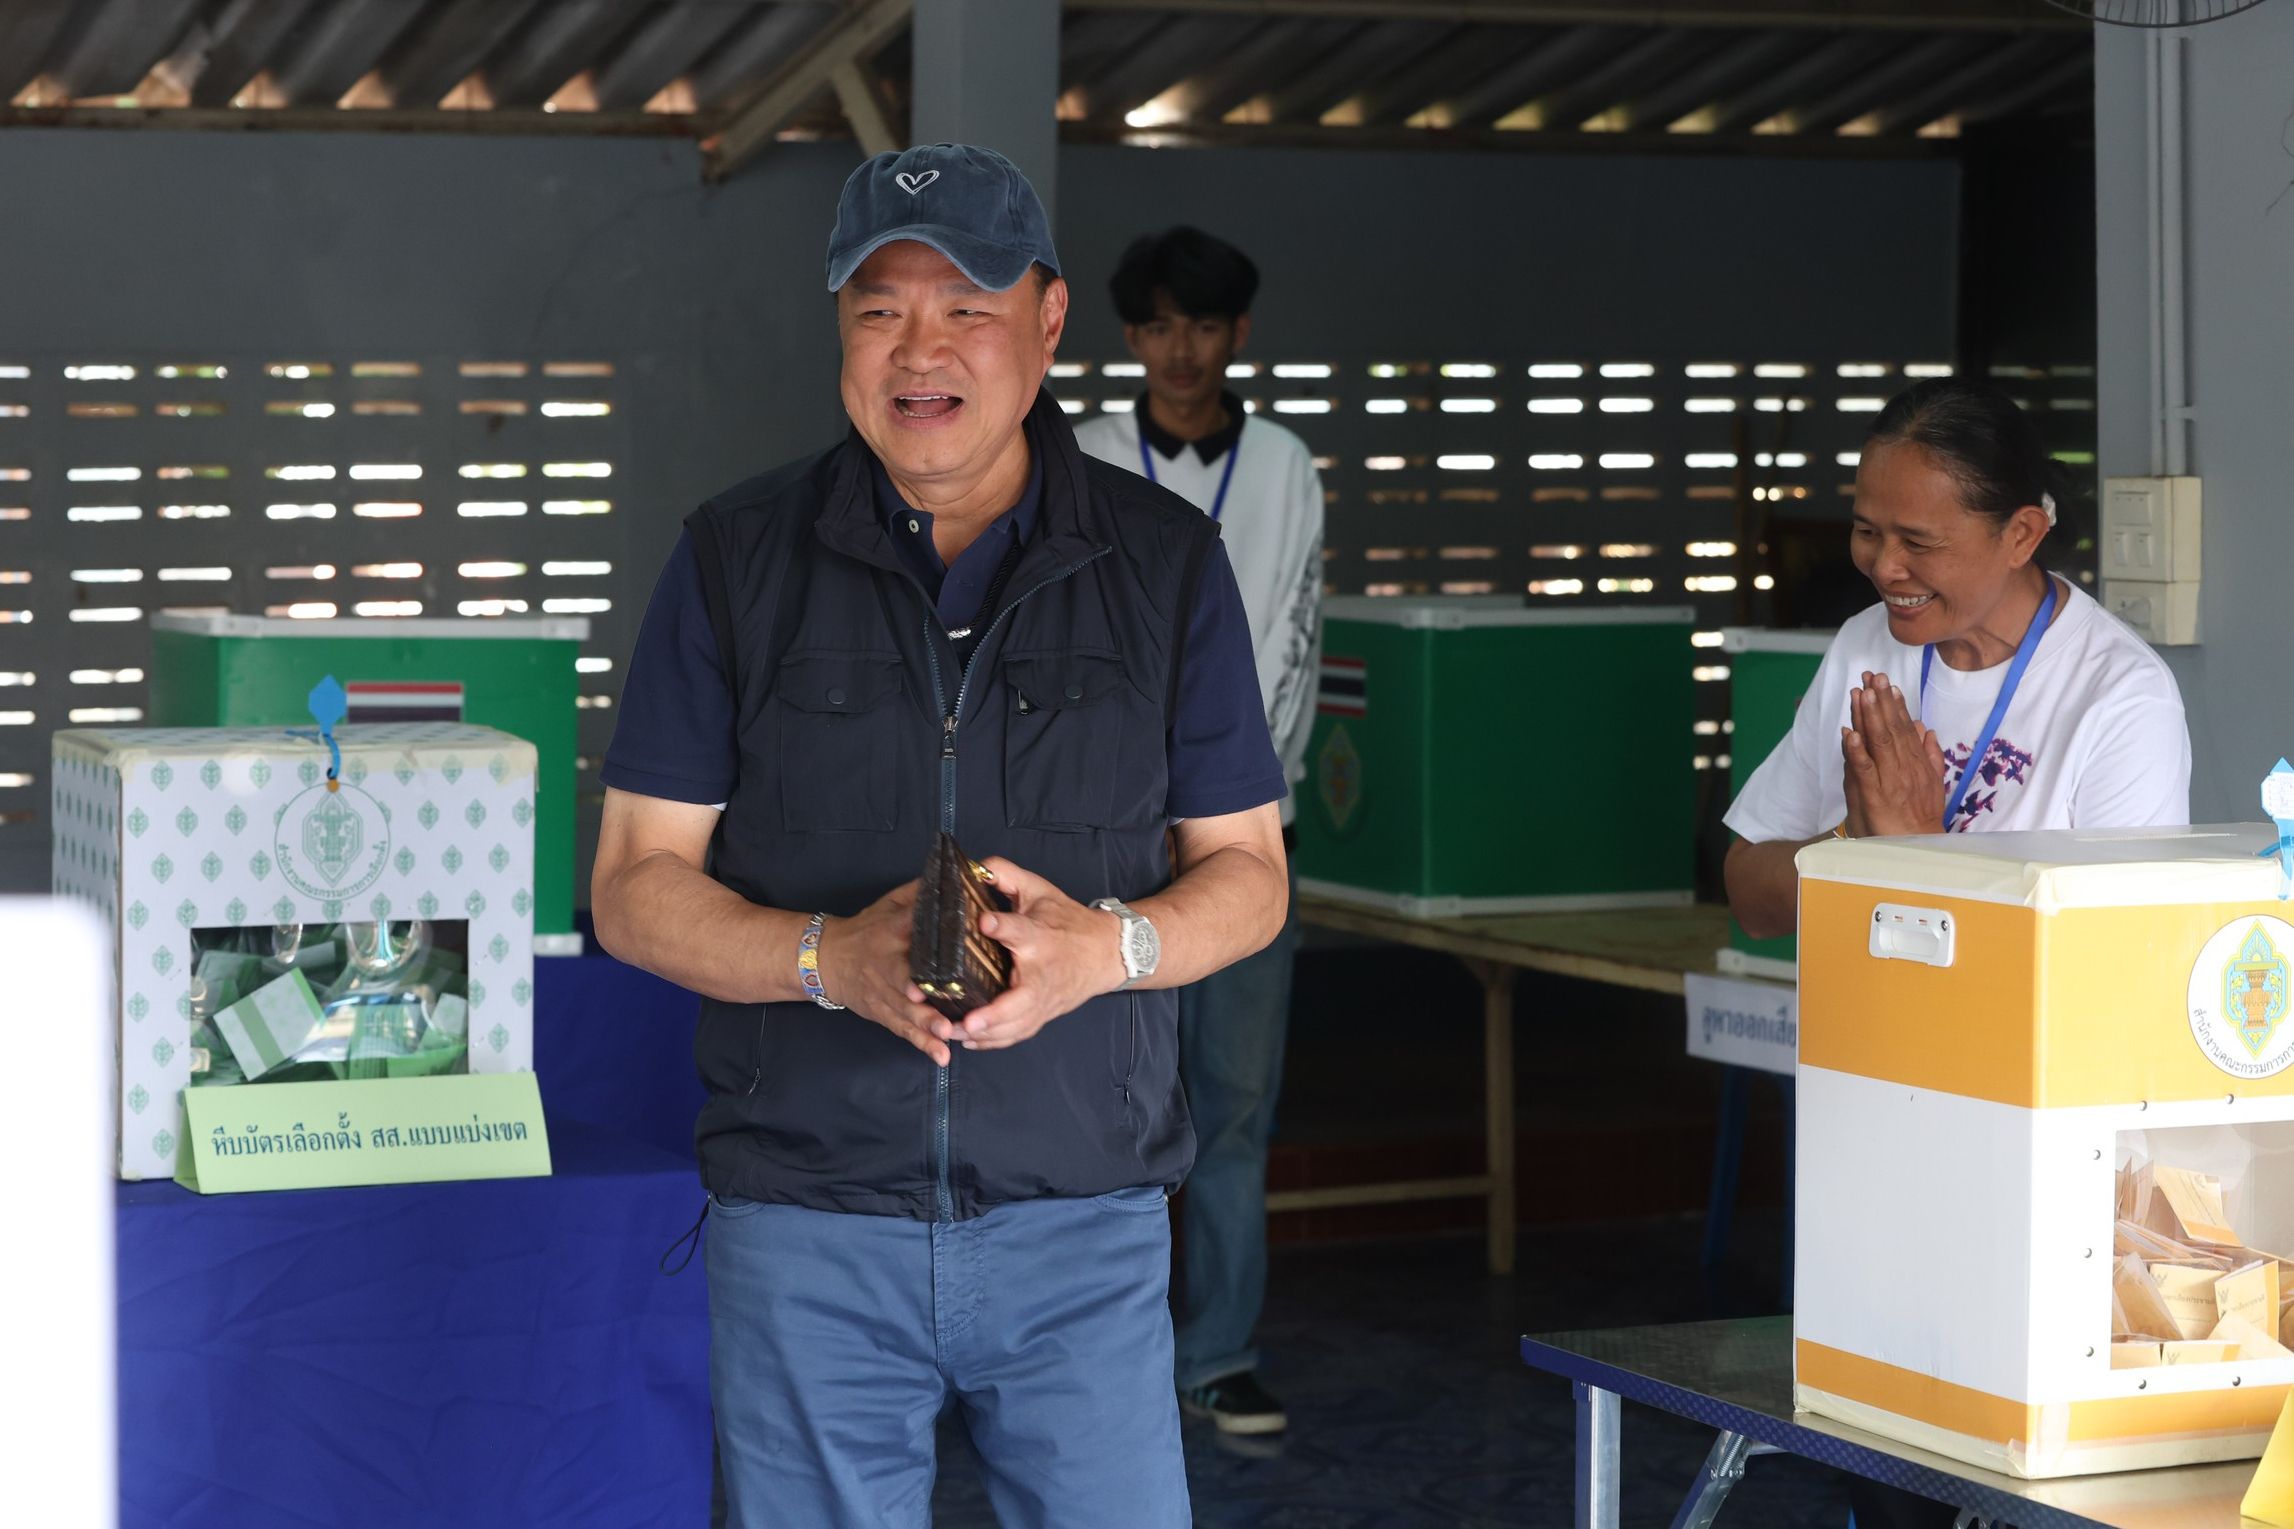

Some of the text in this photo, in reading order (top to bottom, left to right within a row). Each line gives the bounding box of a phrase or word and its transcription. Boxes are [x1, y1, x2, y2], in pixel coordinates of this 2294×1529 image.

[211, 1112, 528, 1156] หีบบัตรเลือกตั้ง สส.แบบแบ่งเขต
